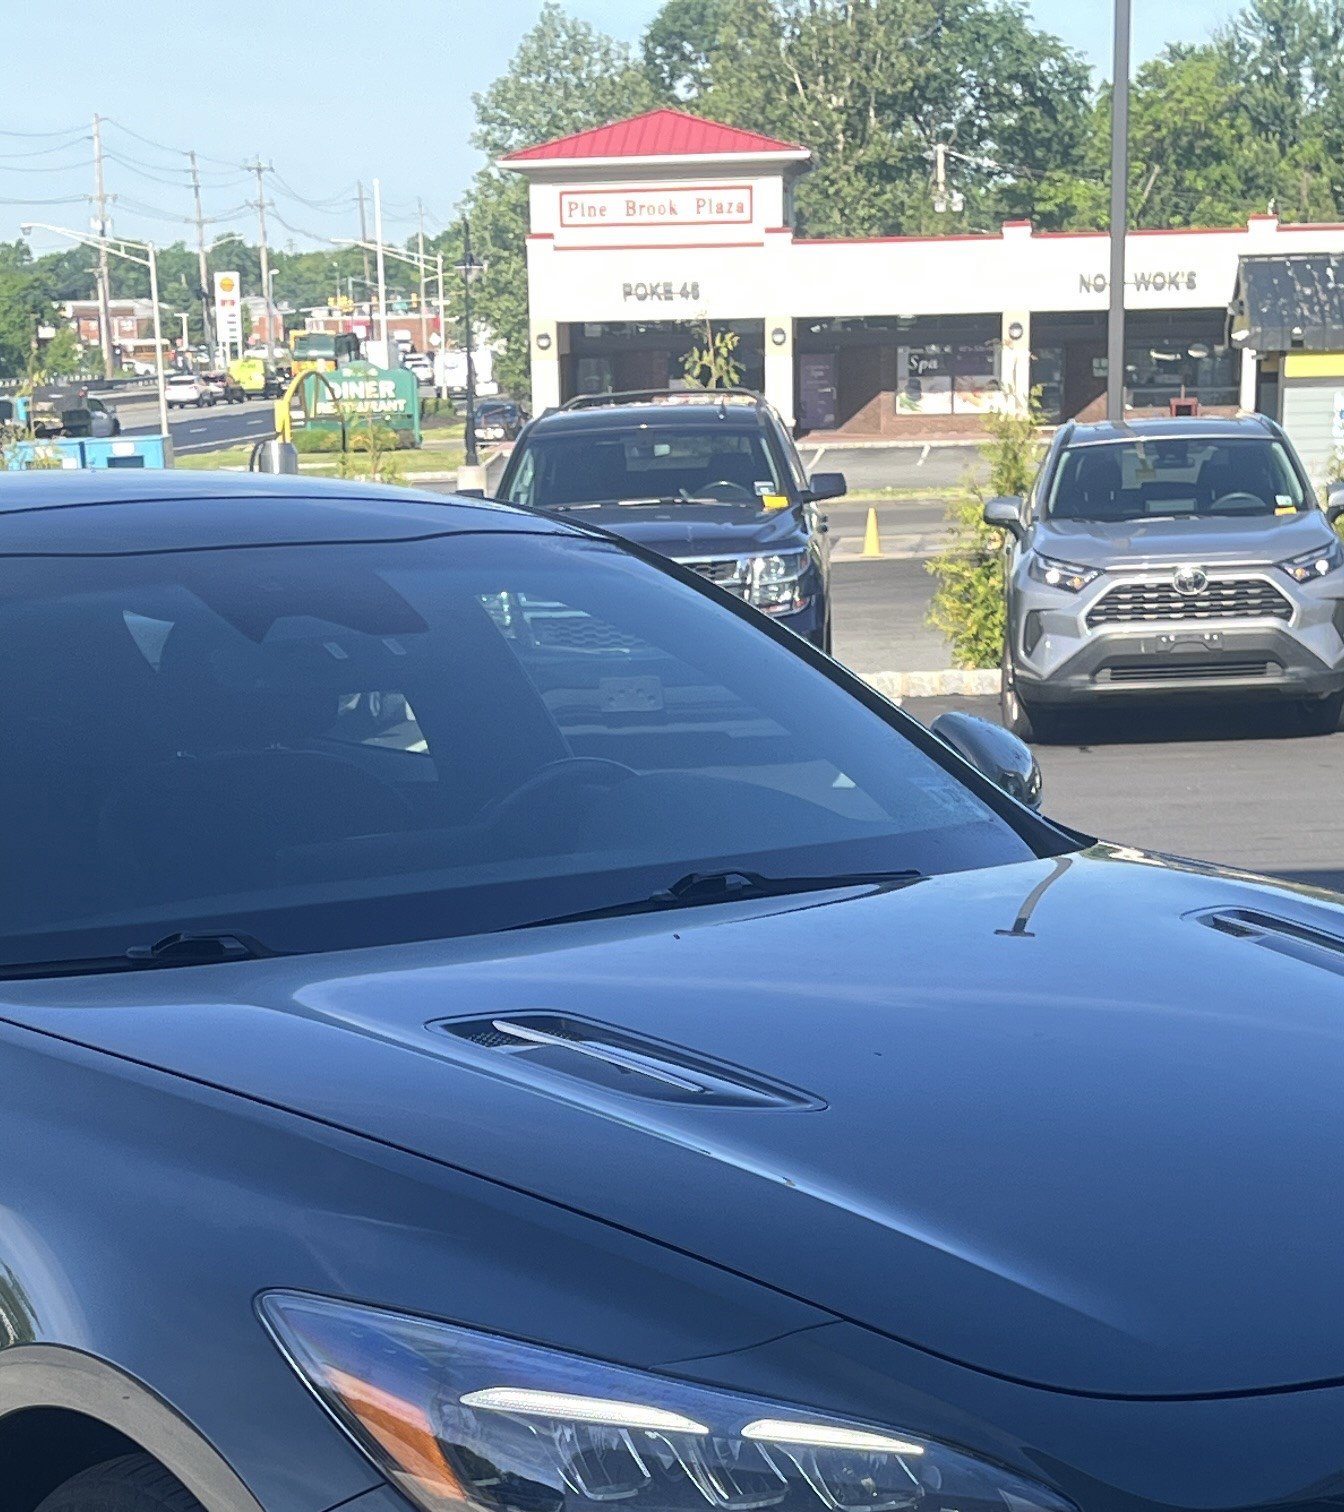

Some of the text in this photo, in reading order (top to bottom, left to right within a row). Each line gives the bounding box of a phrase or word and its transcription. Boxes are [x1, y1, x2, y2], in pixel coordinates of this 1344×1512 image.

[567, 198, 745, 218] Pine Brook Plaza
[1134, 270, 1197, 292] WOK'S
[622, 281, 700, 302] POKE 46
[907, 354, 939, 374] Spa
[325, 380, 396, 400] DINER
[317, 399, 407, 414] RETAURANT
